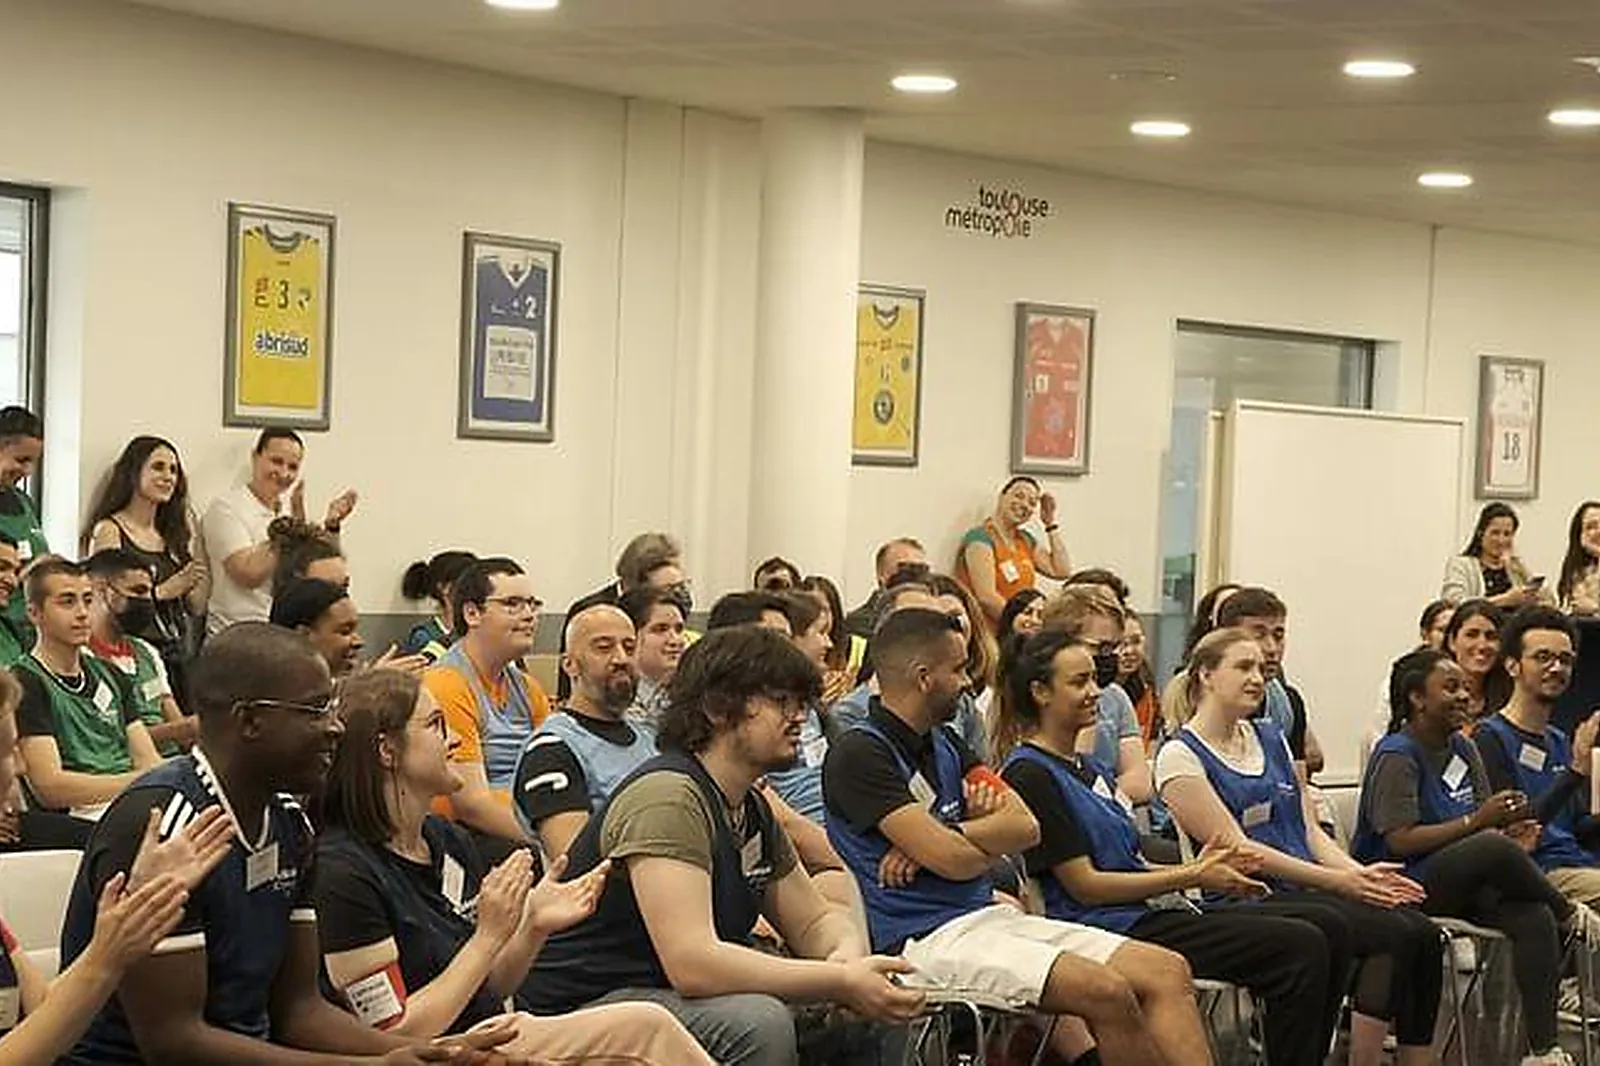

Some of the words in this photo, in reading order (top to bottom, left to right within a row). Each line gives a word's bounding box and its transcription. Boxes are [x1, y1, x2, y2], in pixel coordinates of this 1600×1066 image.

[980, 185, 1048, 217] toulouse
[278, 280, 289, 309] 3
[525, 295, 537, 319] 2
[1502, 431, 1521, 461] 18
